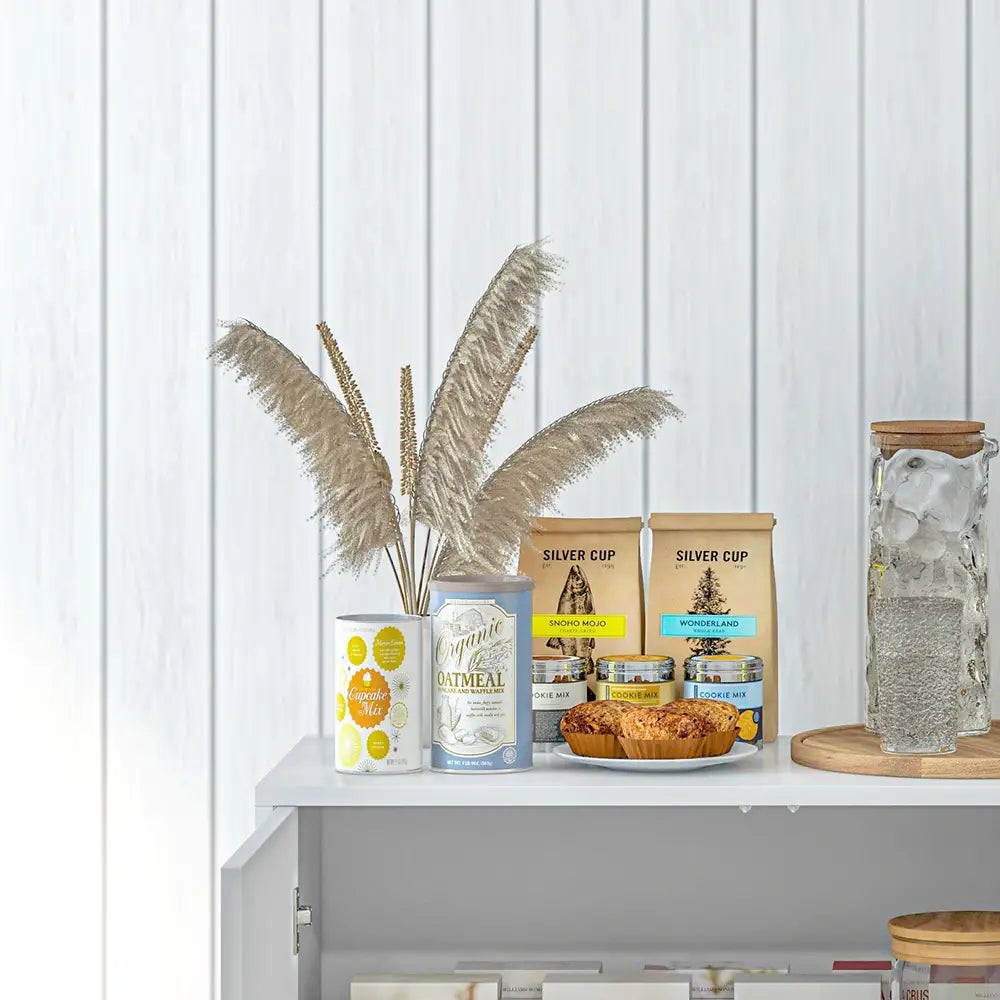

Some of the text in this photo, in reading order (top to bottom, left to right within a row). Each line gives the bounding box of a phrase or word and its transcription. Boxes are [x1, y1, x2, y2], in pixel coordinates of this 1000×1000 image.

[543, 550, 616, 561] SILVER CUP
[676, 550, 748, 562] SILVER CUP
[436, 617, 503, 667] Organic
[437, 670, 505, 688] OATMEAL
[349, 688, 387, 703] Cupcake
[556, 689, 570, 698] MIX
[611, 690, 658, 699] COOKIE MIX
[699, 690, 747, 699] COOKIE MIX
[359, 702, 383, 716] Mix
